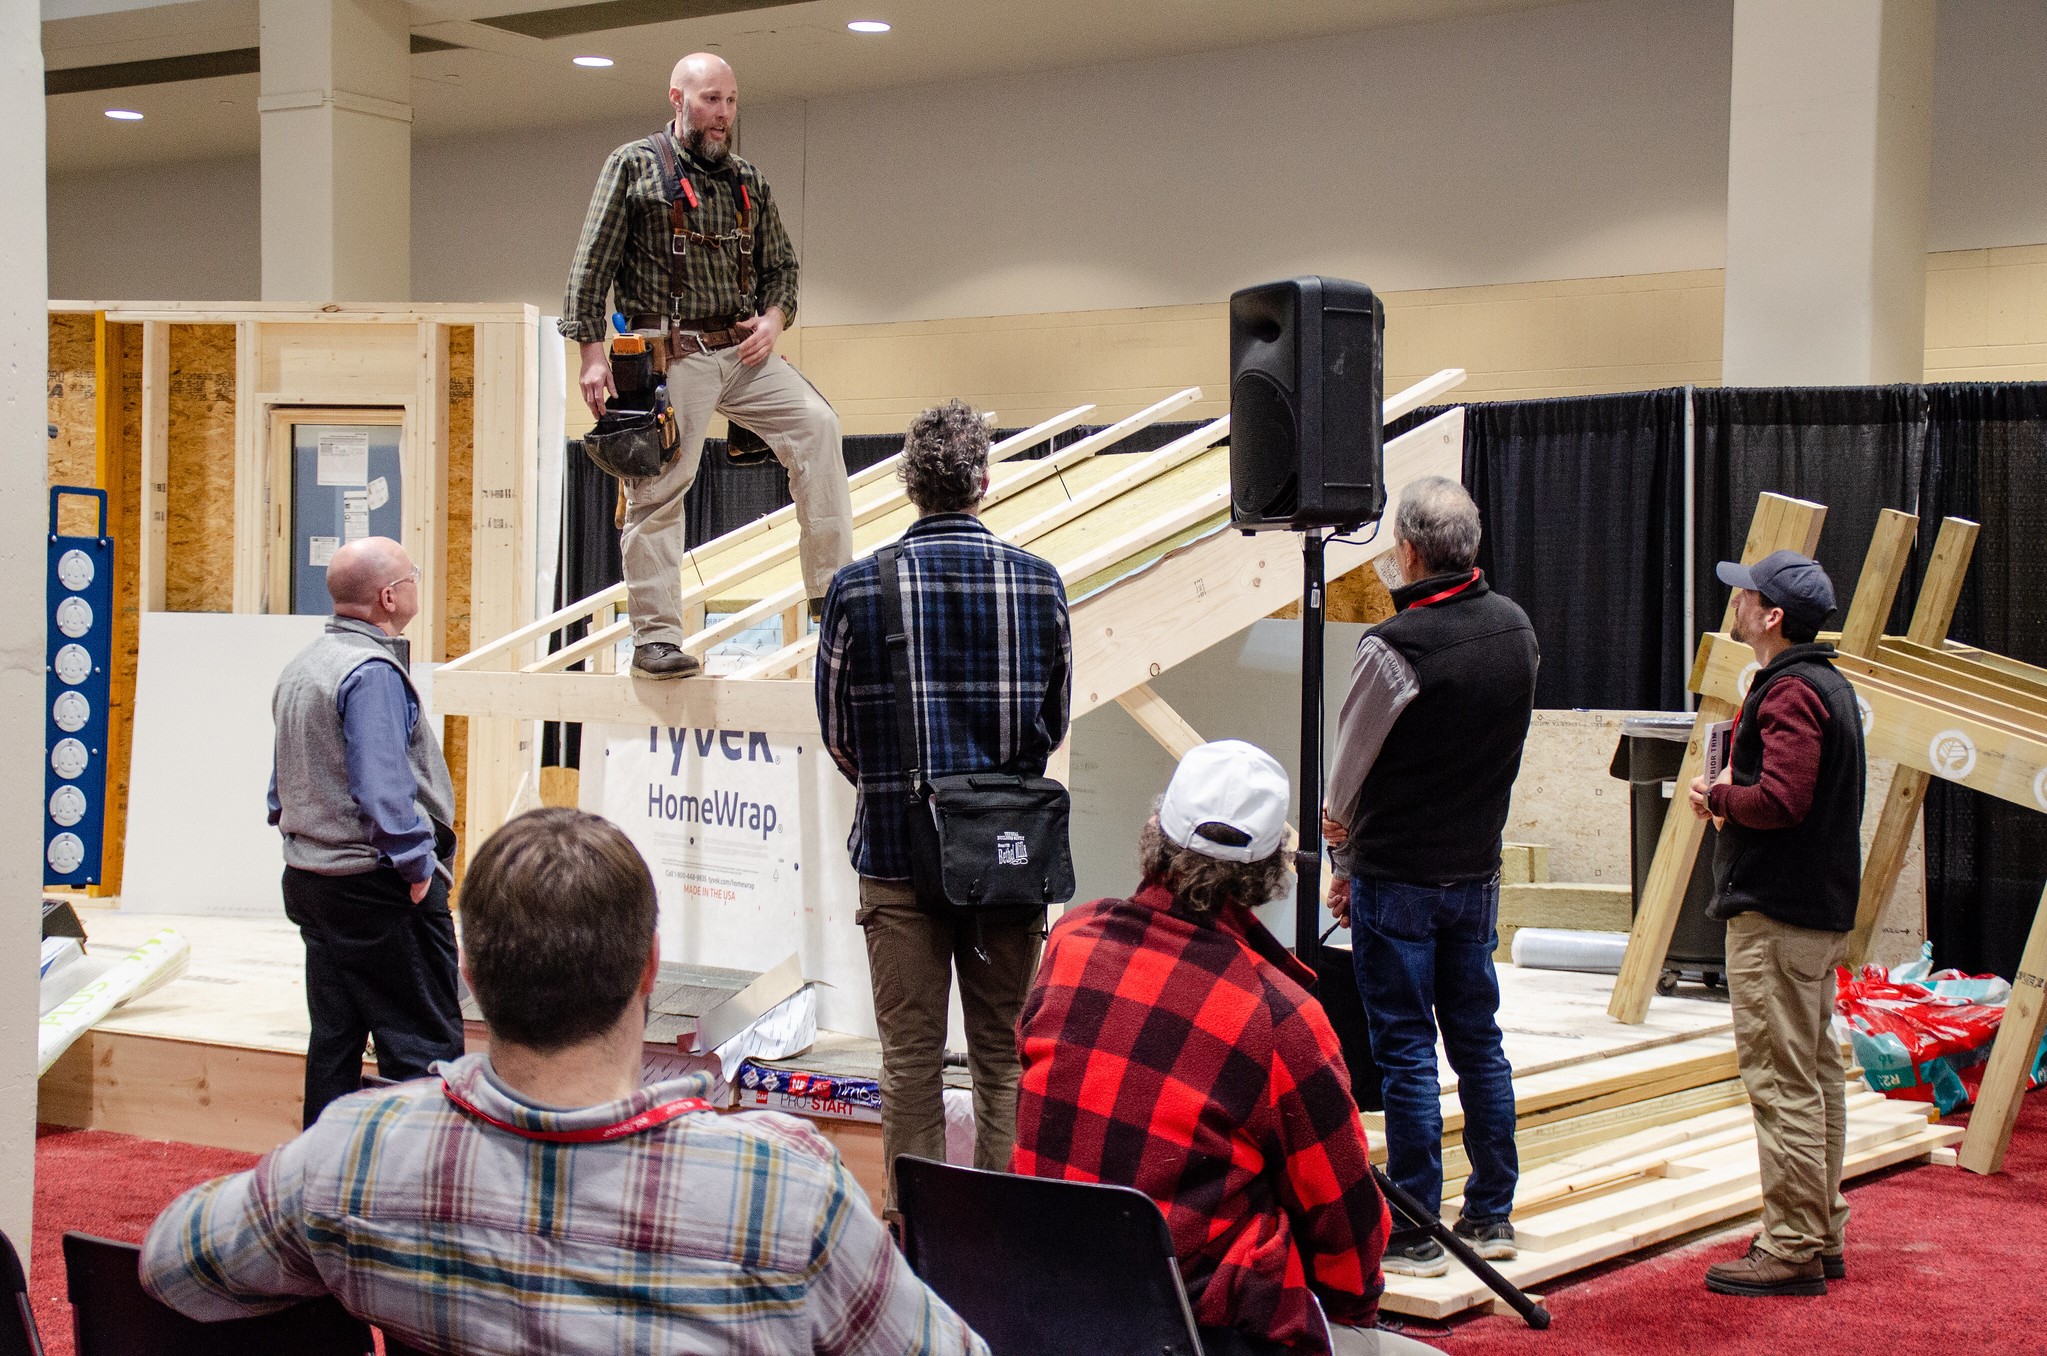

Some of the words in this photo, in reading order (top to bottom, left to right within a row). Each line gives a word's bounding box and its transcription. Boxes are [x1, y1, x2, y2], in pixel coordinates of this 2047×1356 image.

[648, 783, 777, 840] HomeWrap
[683, 884, 701, 896] MADE
[702, 887, 709, 897] IN
[710, 888, 722, 899] THE
[723, 889, 736, 901] USA
